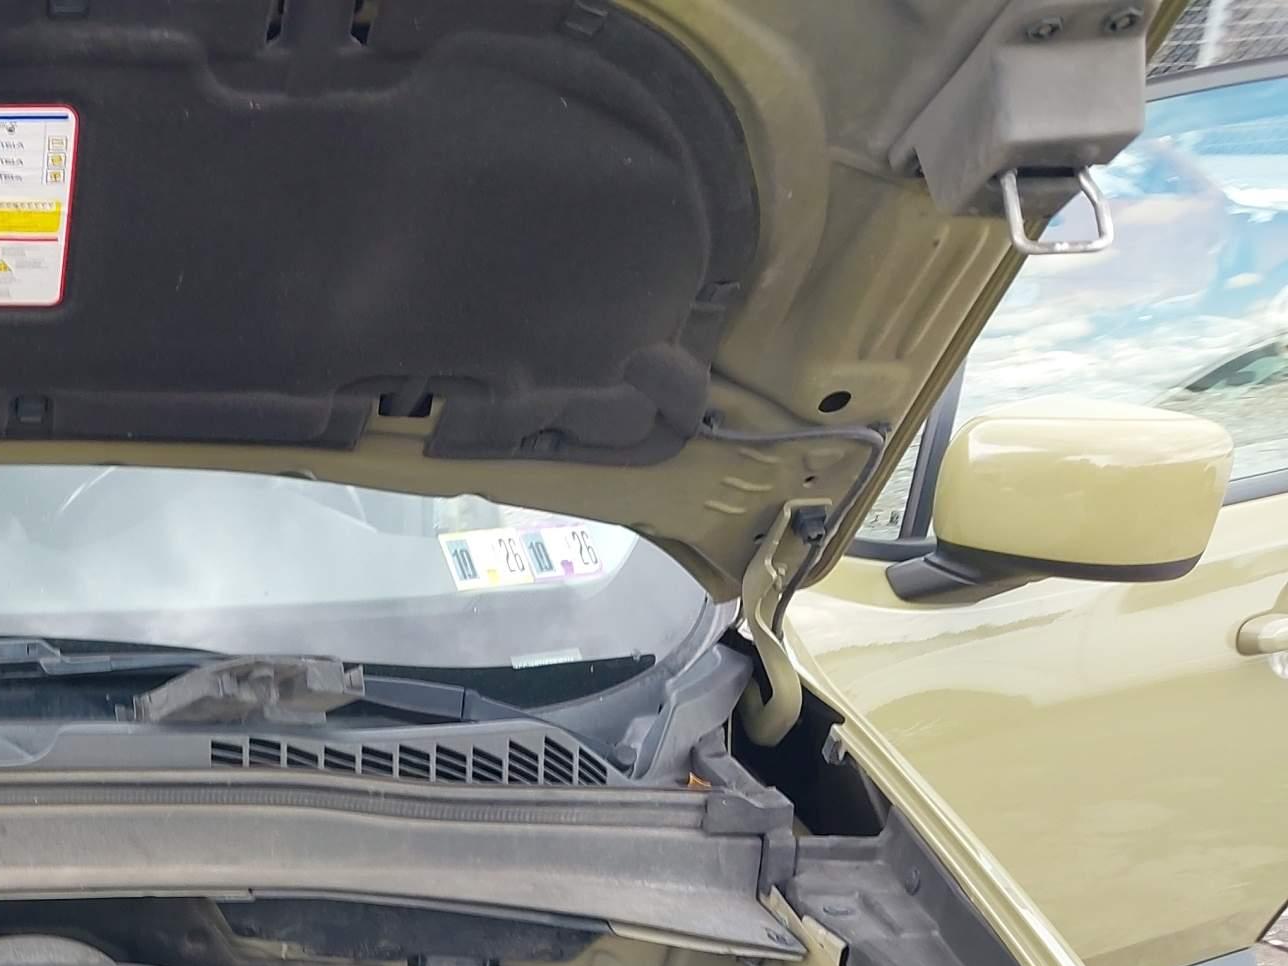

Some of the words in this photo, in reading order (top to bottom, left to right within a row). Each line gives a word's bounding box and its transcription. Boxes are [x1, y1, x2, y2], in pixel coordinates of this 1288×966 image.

[452, 548, 479, 580] 10
[498, 537, 526, 573] 26
[527, 541, 554, 573] 10
[571, 530, 599, 566] 26
